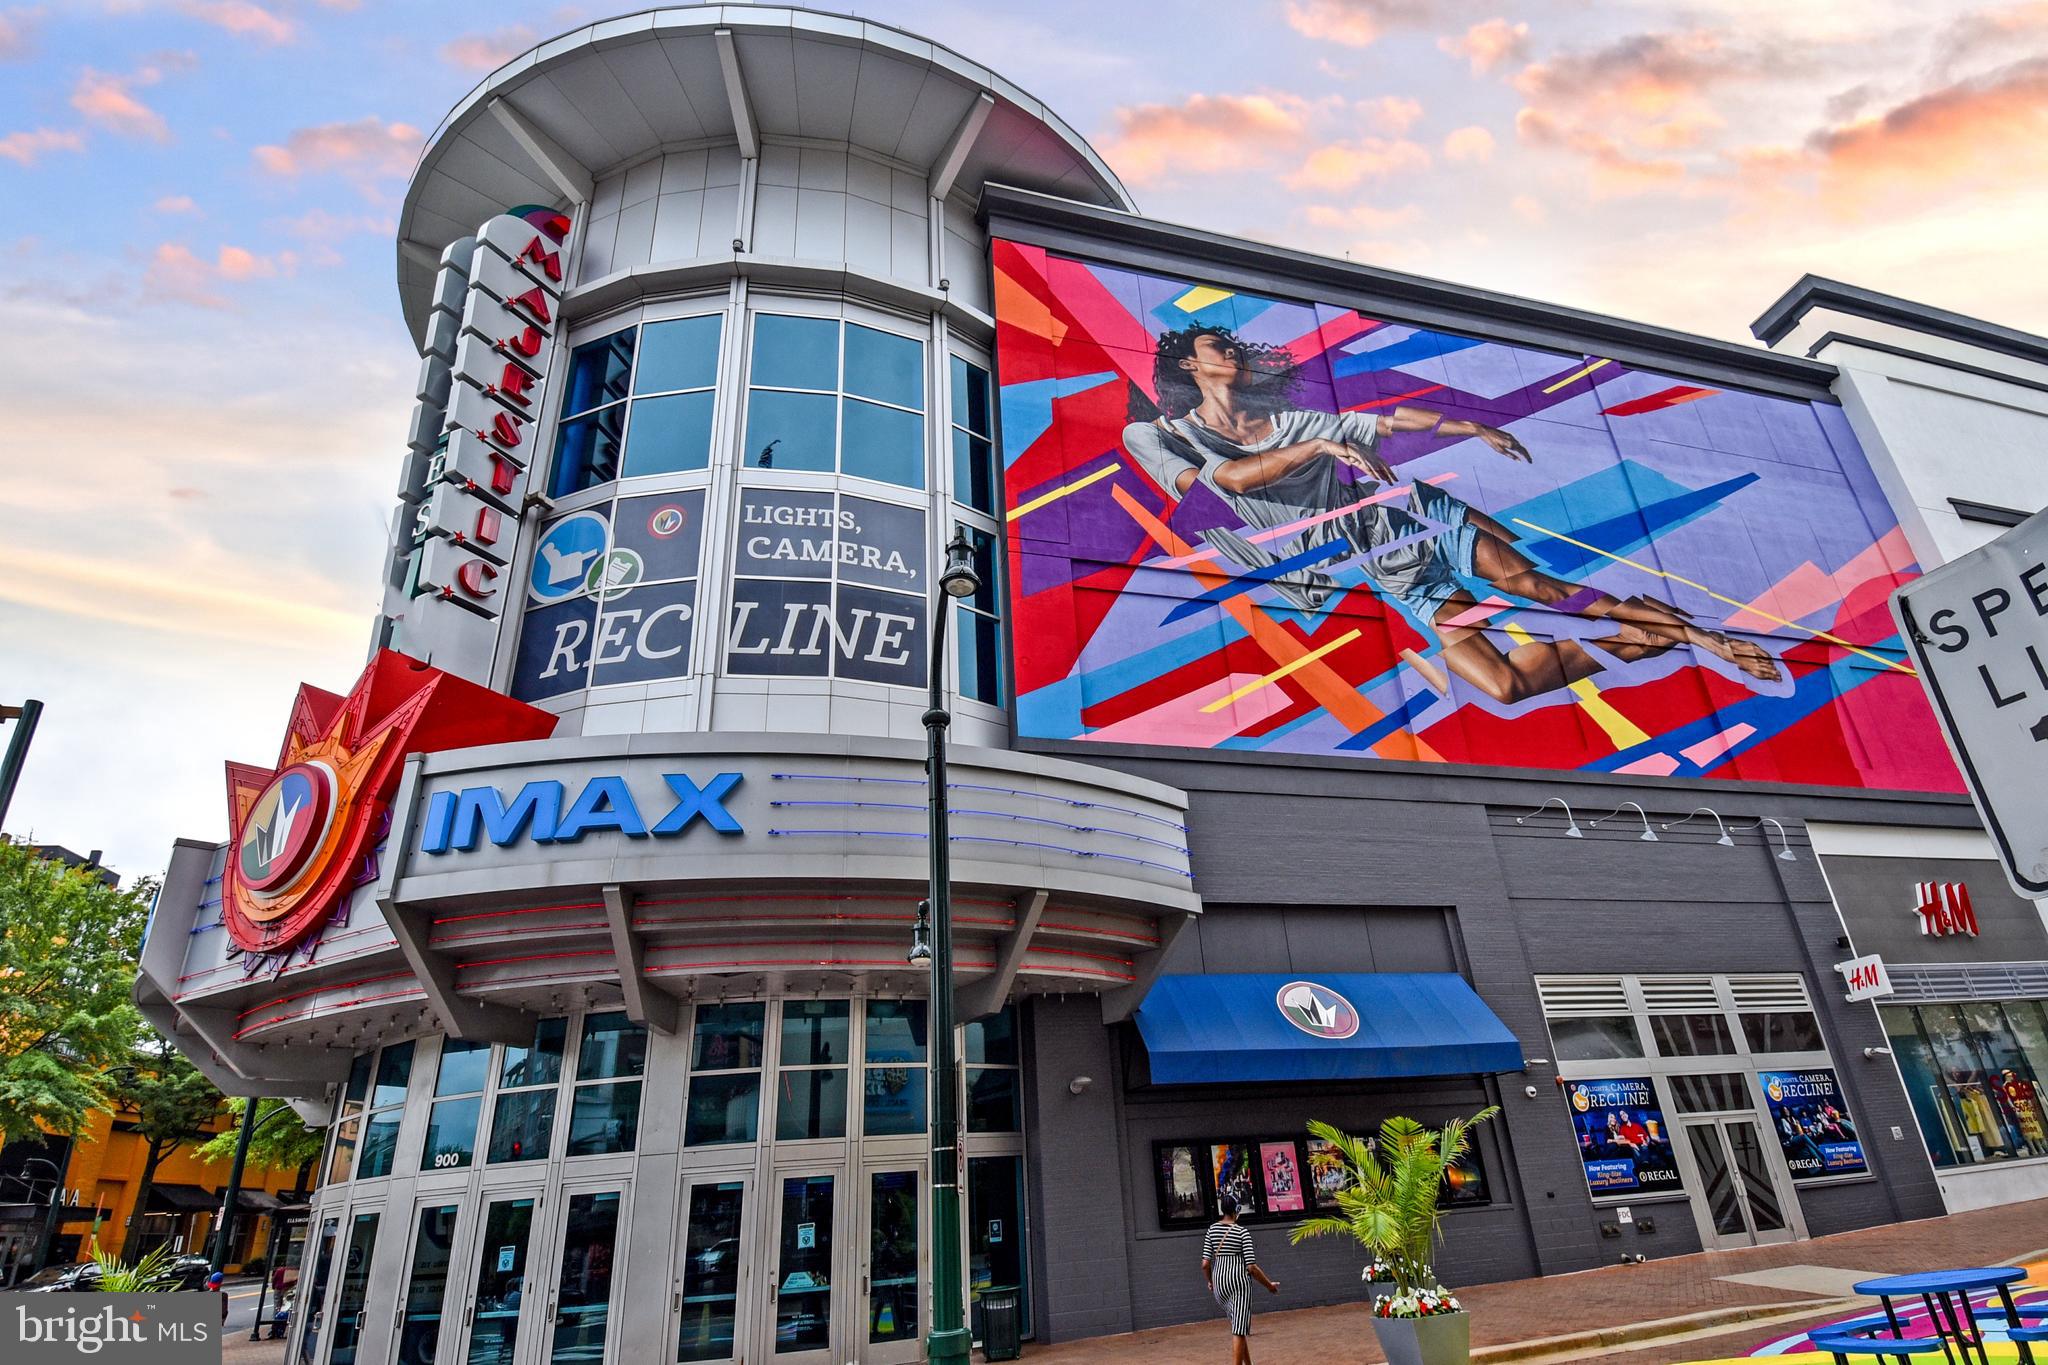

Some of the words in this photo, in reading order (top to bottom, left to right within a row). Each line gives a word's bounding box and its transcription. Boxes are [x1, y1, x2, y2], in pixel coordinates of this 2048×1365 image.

[457, 235, 562, 599] MAJESTIC
[744, 504, 862, 534] LIGHTS,
[746, 536, 917, 579] CAMERA,
[421, 772, 744, 855] IMAX
[1911, 879, 1980, 938] H&M
[1849, 963, 1879, 992] H&M
[1590, 1091, 1650, 1108] RECLINE!
[1783, 1082, 1834, 1098] RECLINE!
[434, 1152, 459, 1168] 900
[1601, 1163, 1627, 1171] Featuring
[1795, 1158, 1823, 1169] REGAL
[1646, 1169, 1678, 1182] REGAL
